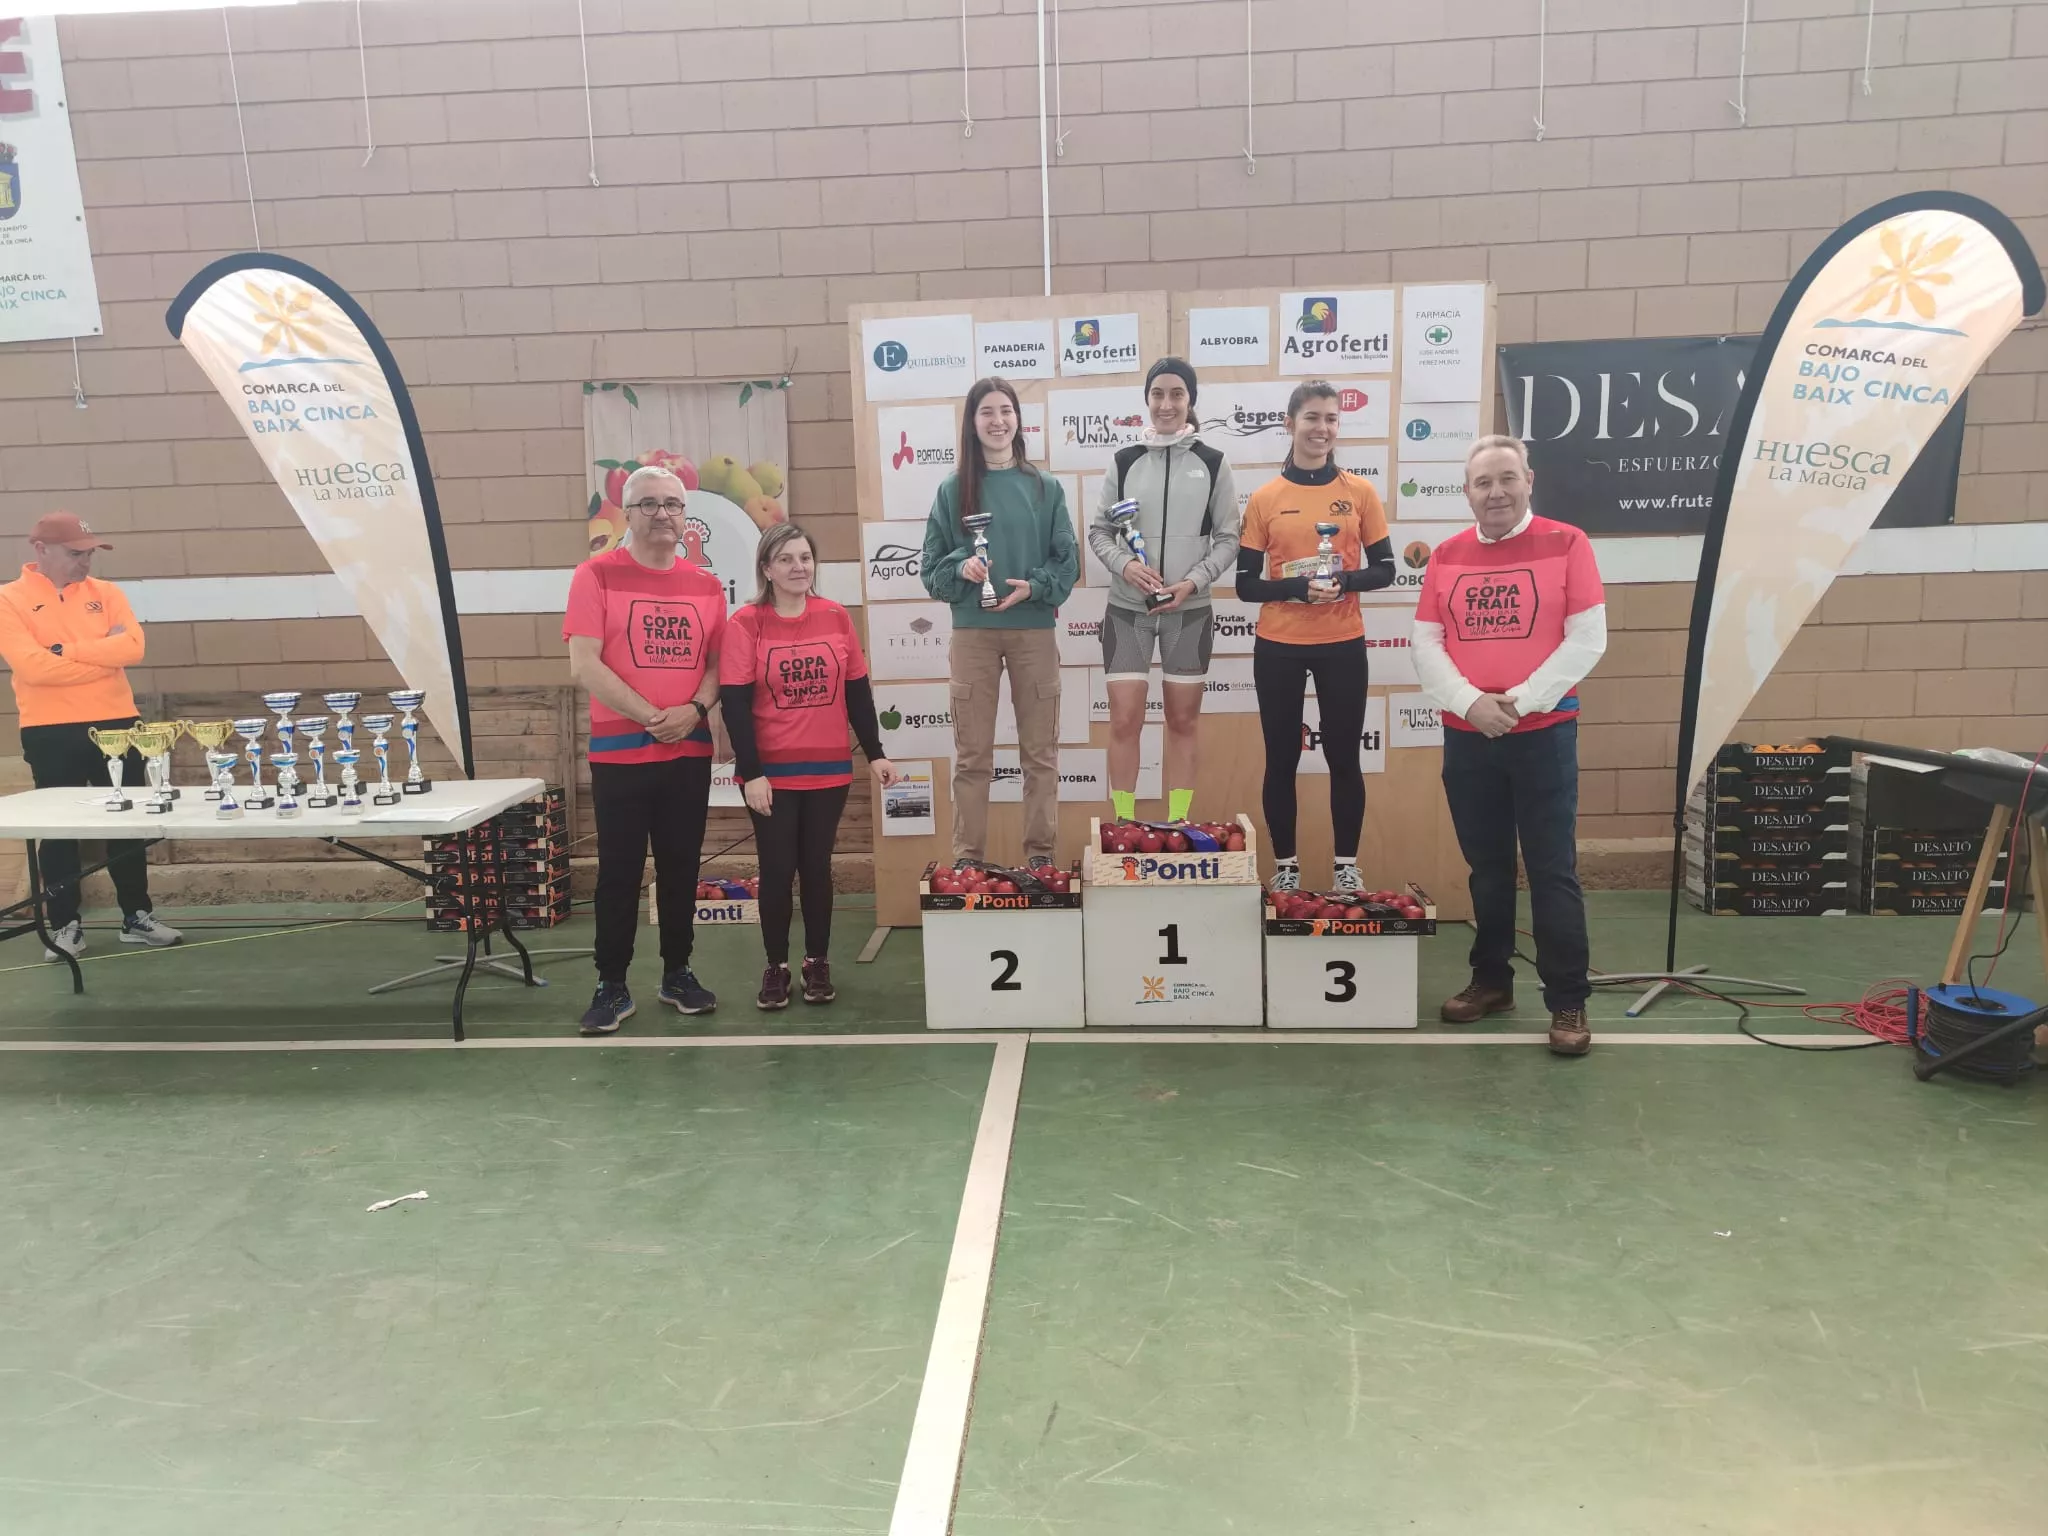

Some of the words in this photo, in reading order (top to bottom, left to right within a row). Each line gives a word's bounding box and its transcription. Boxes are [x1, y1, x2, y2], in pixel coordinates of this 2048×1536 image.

[21, 288, 67, 301] CINCA
[1416, 310, 1461, 319] FARMACIA
[984, 343, 1045, 353] PANADERIA
[1200, 336, 1258, 346] ALBYOBRA
[1284, 333, 1388, 358] Agroferti
[1064, 344, 1136, 363] Agroferti
[1805, 343, 1897, 365] COMARCA
[1901, 357, 1928, 368] DEL
[993, 359, 1037, 368] CASADO
[1798, 360, 1860, 383] BAJO
[242, 383, 320, 395] COMARCA
[324, 383, 345, 392] DEL
[1792, 384, 1855, 405] BAIX
[1863, 380, 1950, 405] CINCA
[248, 399, 296, 415] BAJO
[304, 405, 378, 422] CINCA
[253, 418, 304, 434] BAIX
[917, 448, 954, 461] PORTOLES
[1465, 584, 1520, 598] COPA
[1465, 597, 1520, 610] TRAIL
[643, 615, 691, 628] COPA
[1215, 614, 1246, 622] Frutas
[1464, 615, 1520, 627] CINCA
[643, 627, 692, 640] TRAIL
[1364, 638, 1411, 647] sall
[644, 645, 691, 657] CINCA
[780, 655, 828, 673] COPA
[780, 667, 828, 684] TRAIL
[783, 685, 828, 697] CINCA
[1142, 858, 1219, 880] Ponti
[983, 894, 1029, 908] Ponti
[694, 904, 743, 921] onti
[1332, 920, 1381, 933] Ponti
[1159, 924, 1188, 964] 1
[990, 949, 1022, 991] 2
[1324, 960, 1357, 1003] 3
